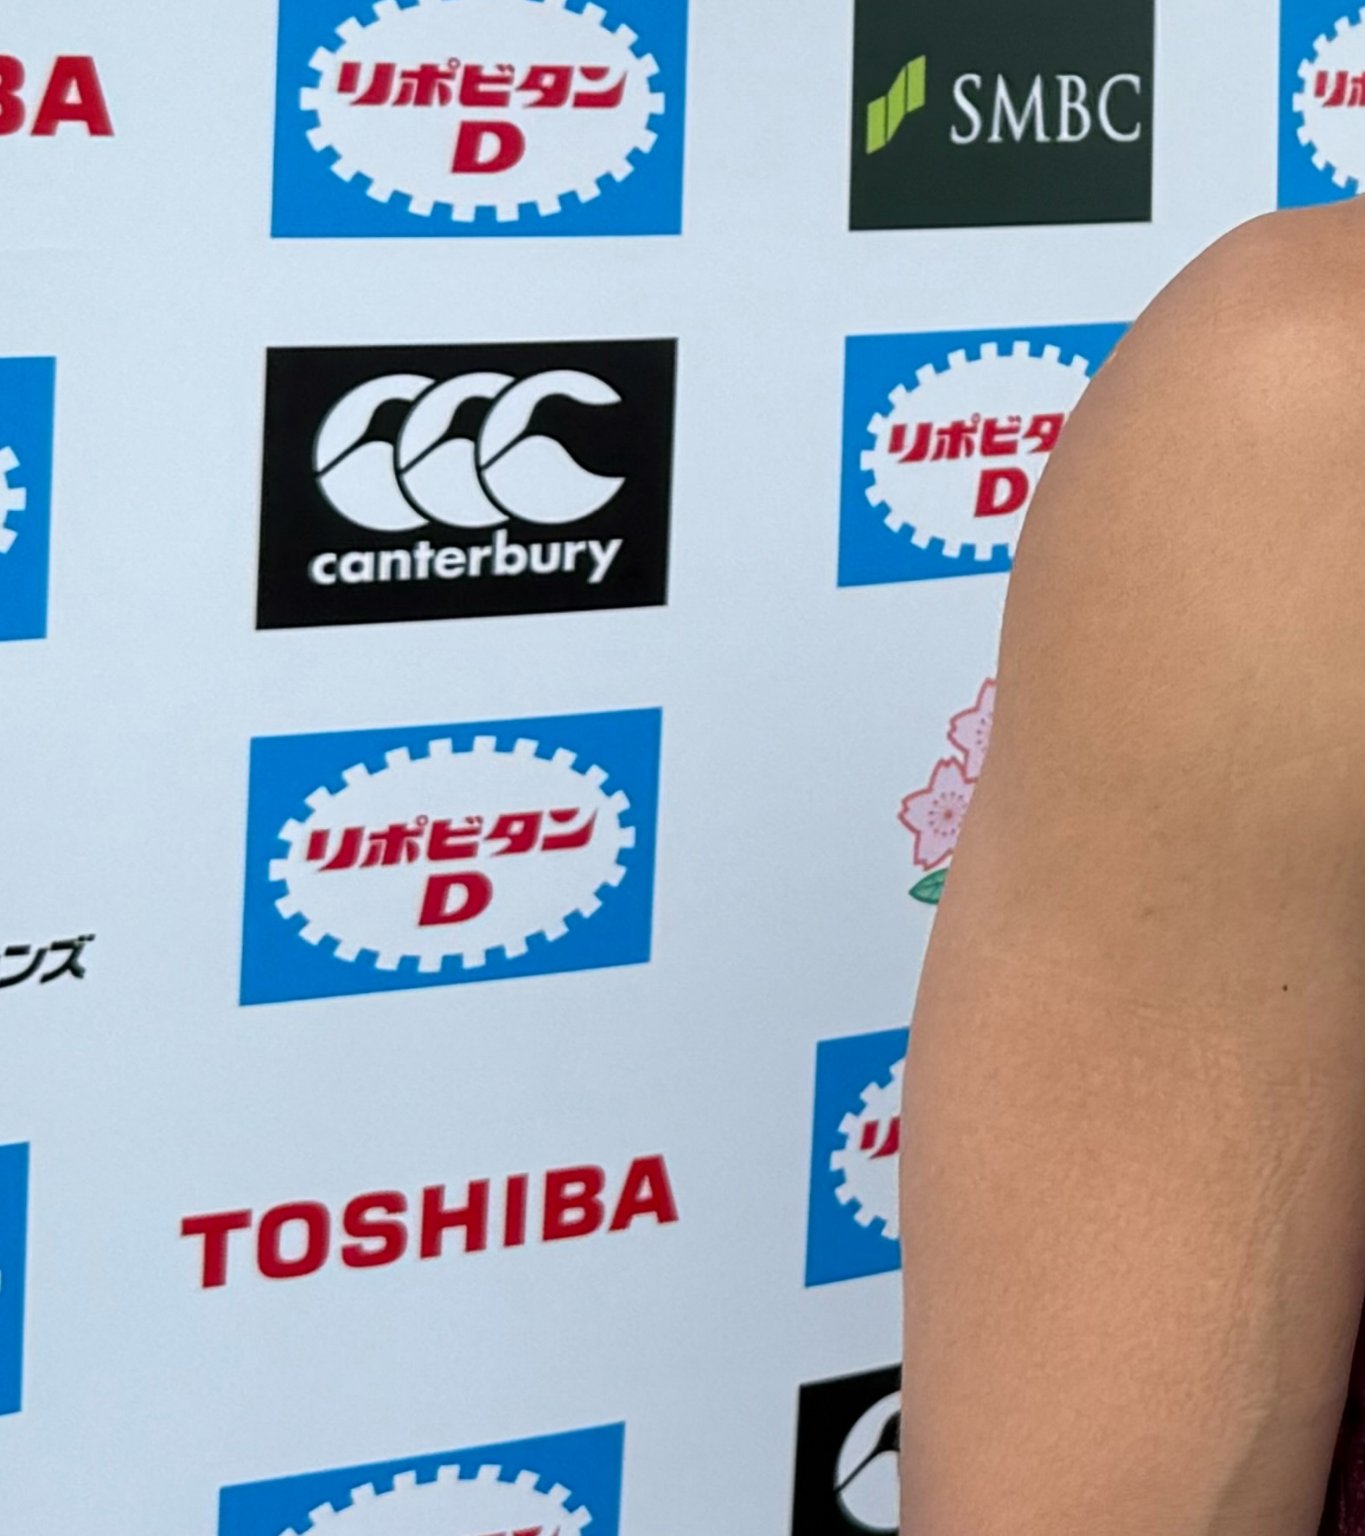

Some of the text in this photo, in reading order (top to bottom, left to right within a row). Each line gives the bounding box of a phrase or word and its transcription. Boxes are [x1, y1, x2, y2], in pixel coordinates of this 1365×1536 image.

[335, 56, 630, 112] リポビタン
[949, 72, 1144, 146] SMBC
[449, 119, 527, 176] D
[972, 465, 1031, 520] D
[308, 530, 624, 587] canterbury
[305, 806, 602, 874] リポビタン
[416, 869, 494, 929] D
[178, 1153, 681, 1291] TOSHIBA
